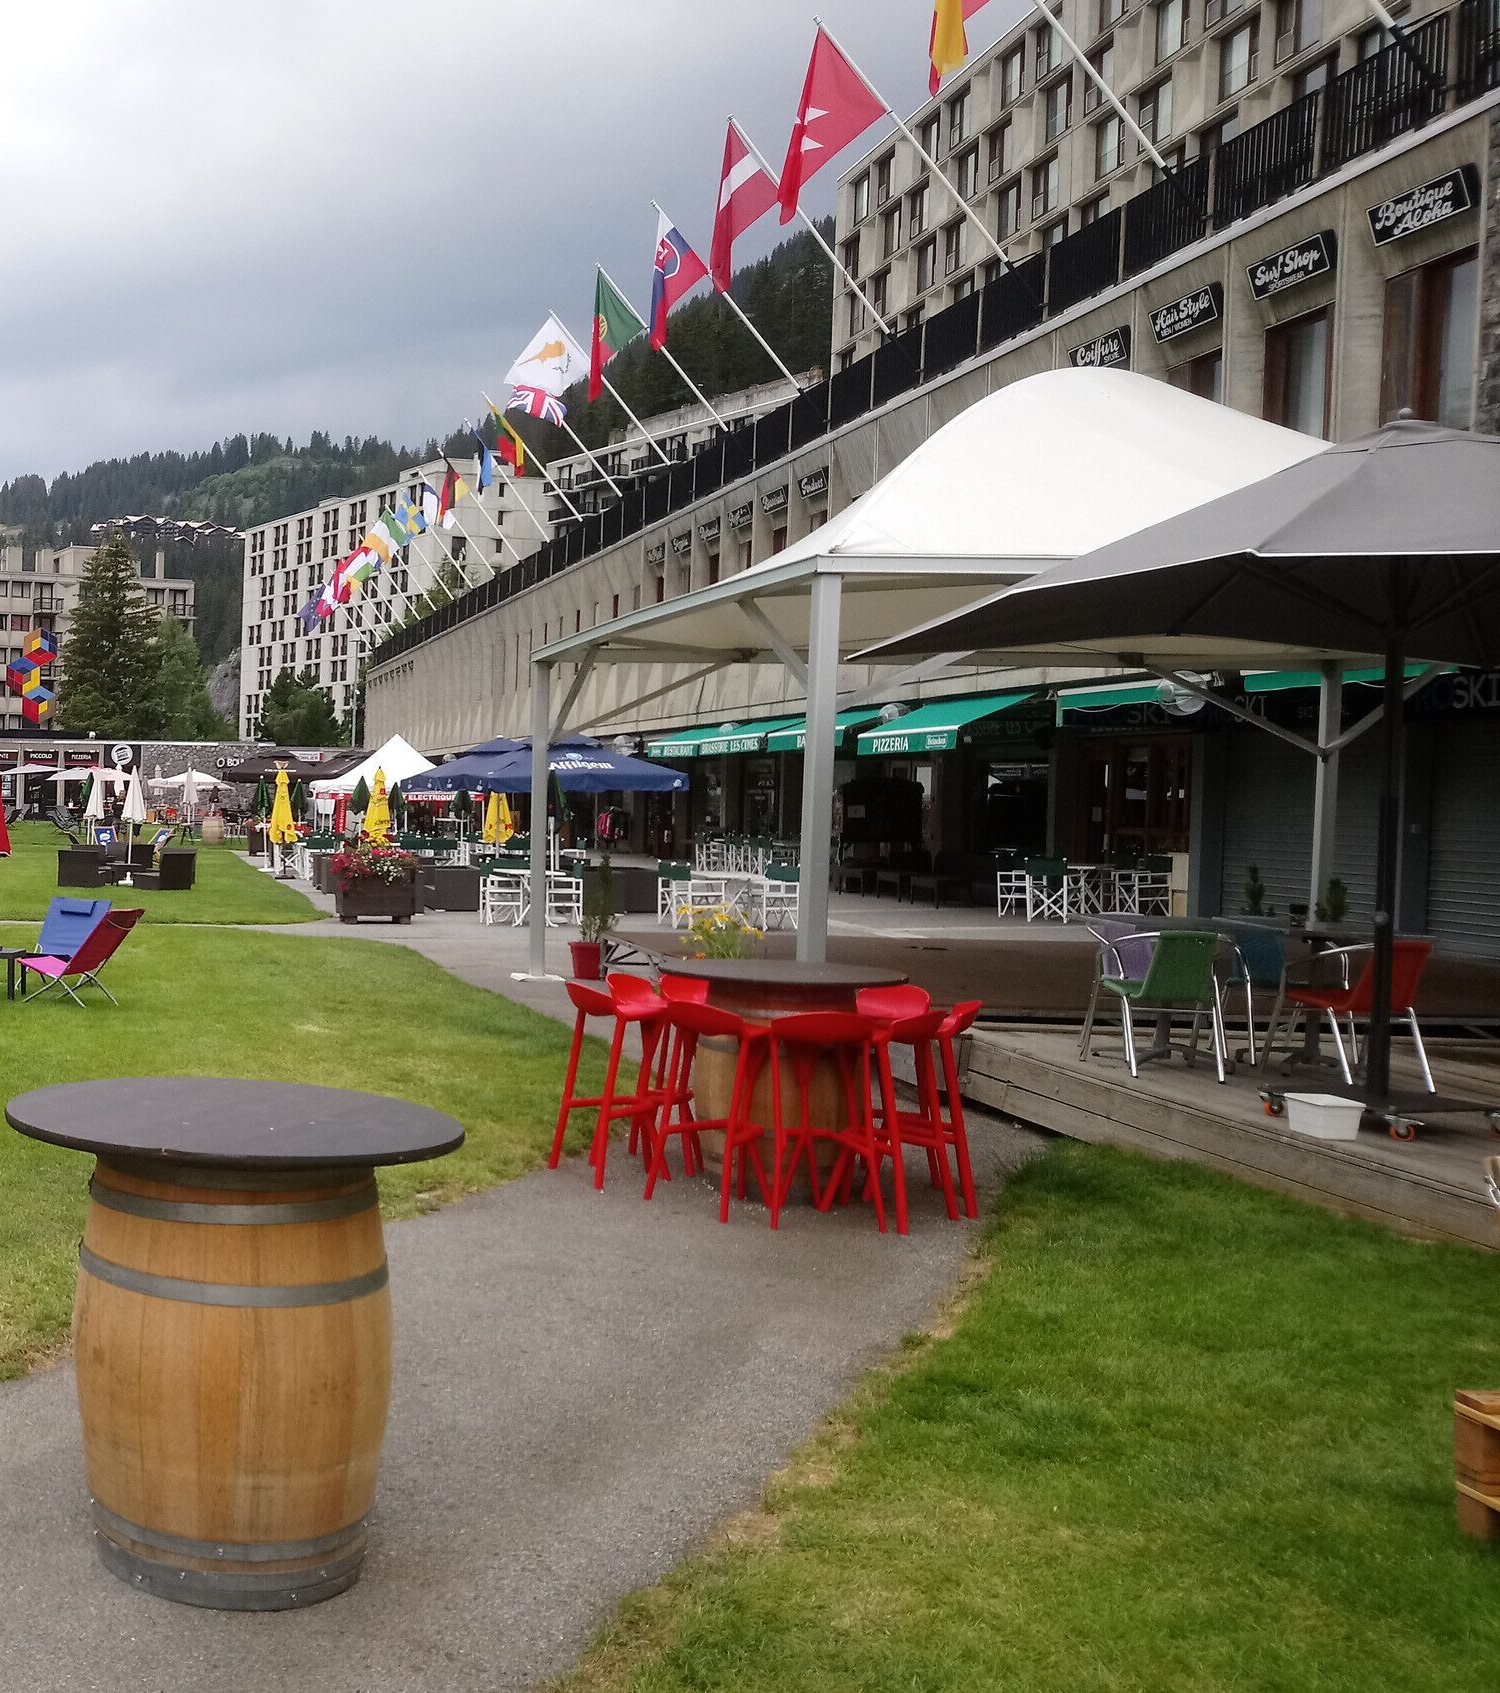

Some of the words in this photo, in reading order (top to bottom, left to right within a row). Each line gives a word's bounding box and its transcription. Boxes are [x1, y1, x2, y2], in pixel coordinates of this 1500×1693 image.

[1375, 181, 1454, 230] Boutique
[1393, 200, 1454, 235] Aloha
[1254, 254, 1284, 286] Surf
[1283, 249, 1321, 274] Shop
[1268, 270, 1306, 292] SPORTSWEAR
[1155, 308, 1179, 332] Hair
[1179, 292, 1211, 319] Style
[1076, 337, 1120, 366] Coiffure
[872, 736, 909, 752] PIZZERIA
